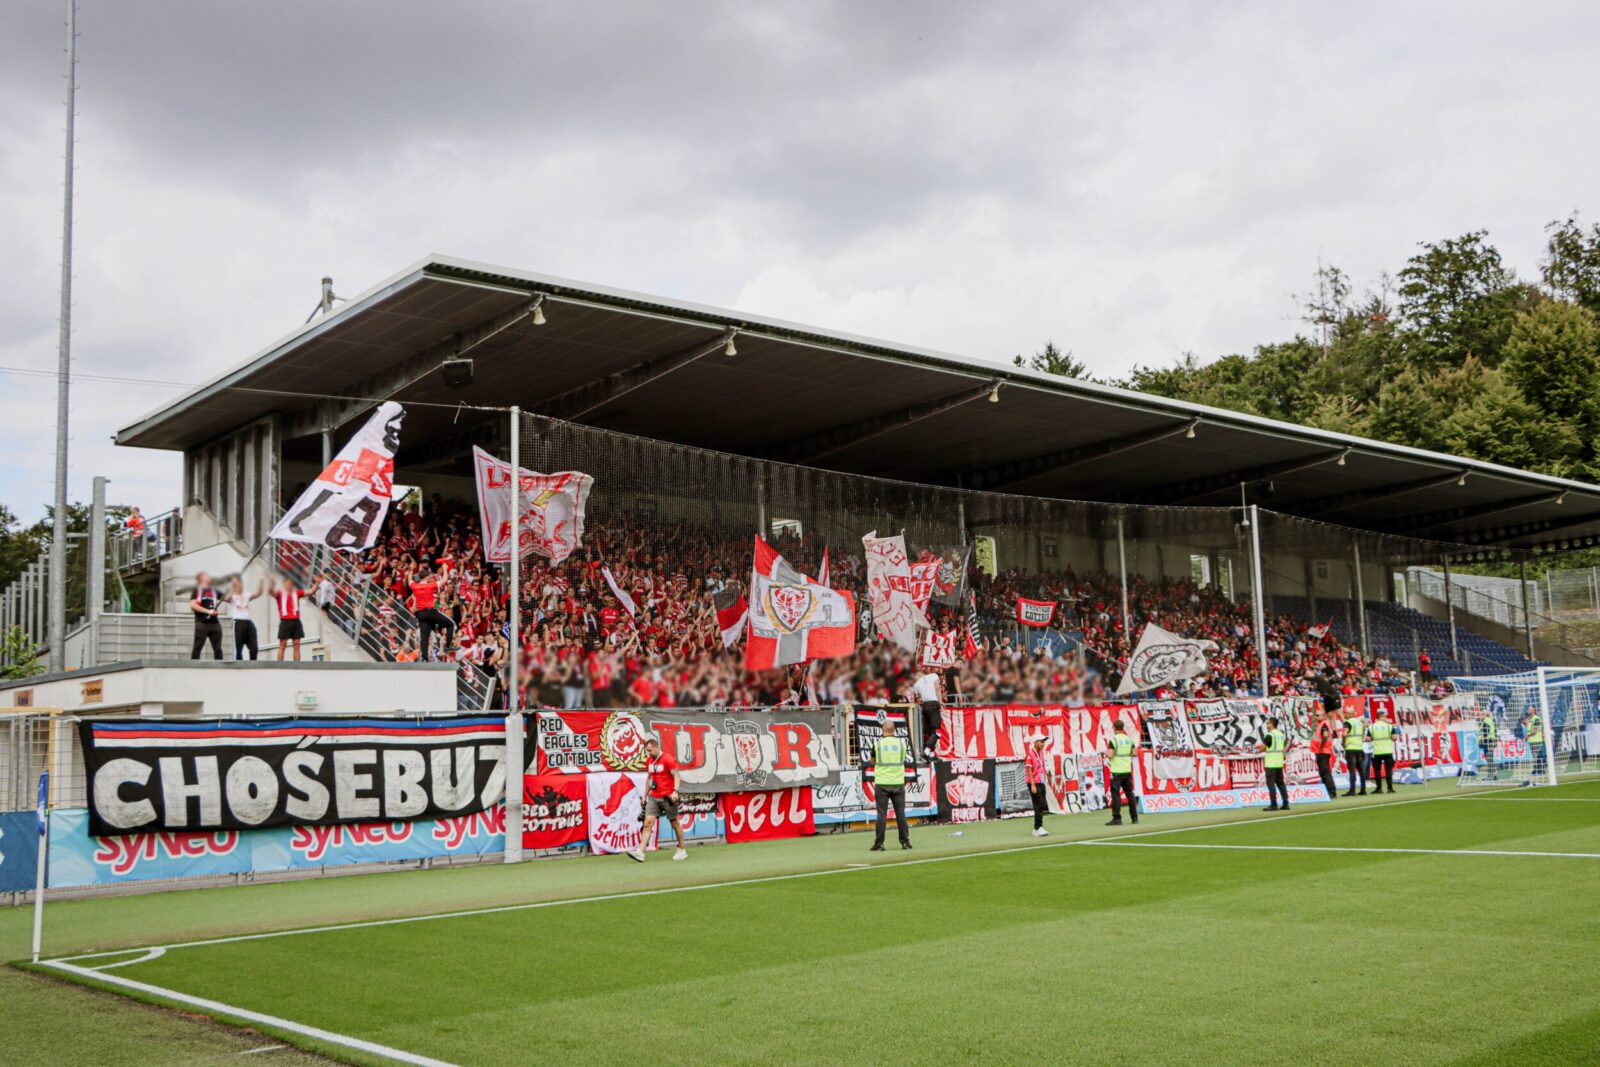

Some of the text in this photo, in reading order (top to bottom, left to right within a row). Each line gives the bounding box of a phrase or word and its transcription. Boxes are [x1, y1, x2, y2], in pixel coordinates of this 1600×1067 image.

[540, 718, 563, 732] RED
[544, 734, 588, 750] EAGLES
[548, 751, 601, 767] COTTBUS
[1231, 757, 1265, 778] energi
[522, 799, 583, 817] RED FIRE
[1146, 796, 1189, 811] syNeo
[1192, 794, 1235, 808] syNeo
[1240, 789, 1279, 804] syNe
[432, 803, 506, 849] syNe
[594, 823, 643, 849] Schnitt
